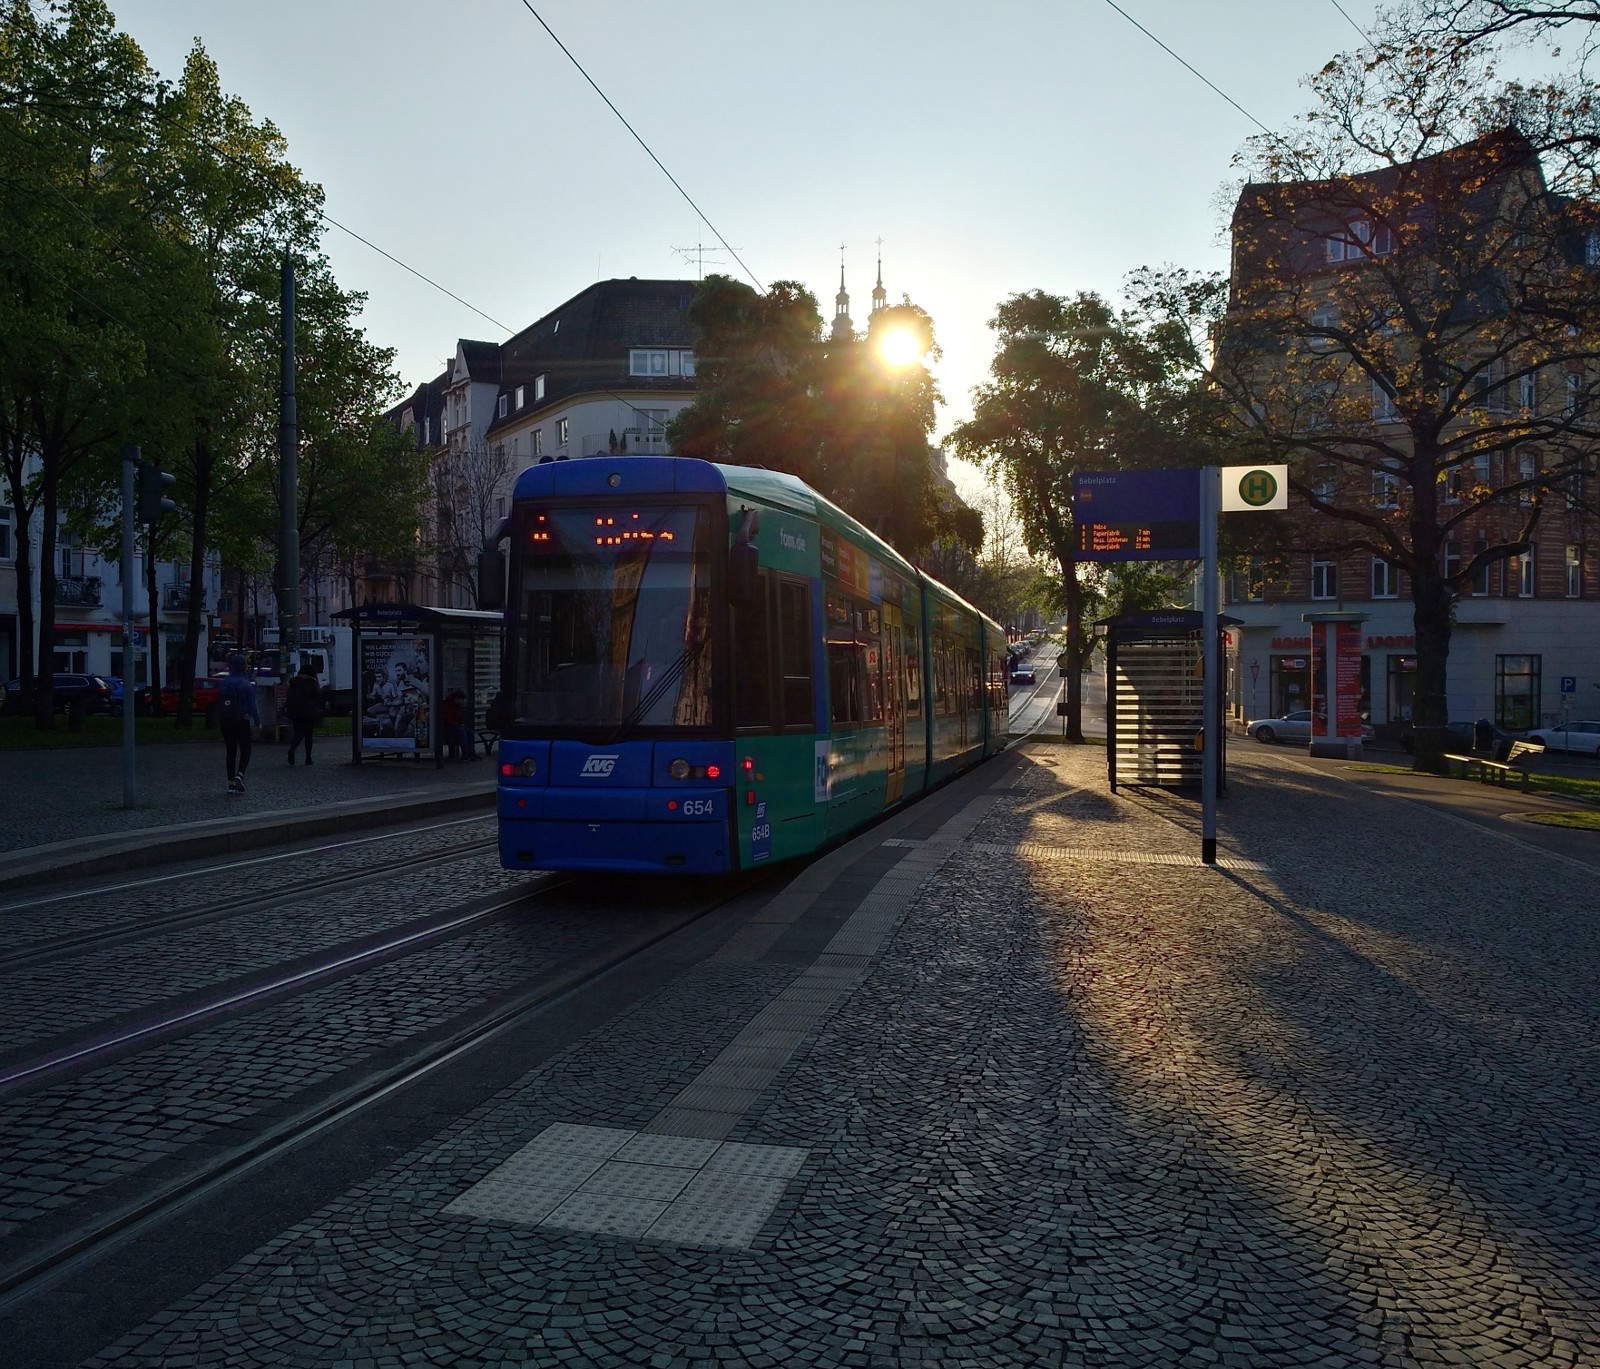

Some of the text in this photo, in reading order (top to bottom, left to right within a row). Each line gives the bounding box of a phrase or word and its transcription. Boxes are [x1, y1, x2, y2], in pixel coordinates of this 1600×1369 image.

[1079, 477, 1117, 485] Bebelplatz
[1248, 478, 1267, 498] H
[1151, 615, 1185, 624] Bebelplatz
[1366, 635, 1416, 649] APOTH
[1564, 678, 1573, 691] P
[581, 757, 617, 774] KVG
[683, 799, 714, 816] 654
[752, 823, 770, 842] 654B
